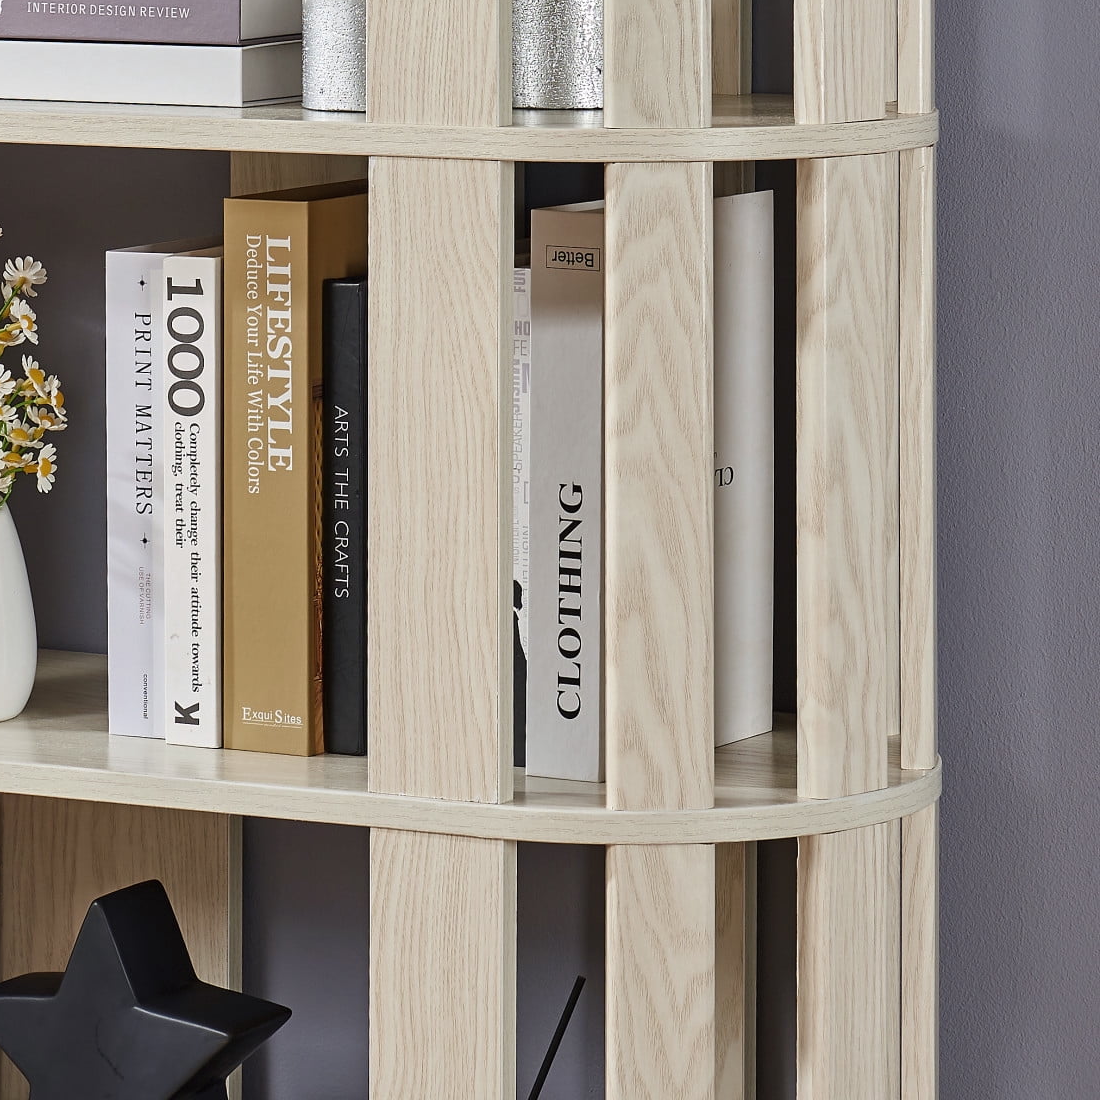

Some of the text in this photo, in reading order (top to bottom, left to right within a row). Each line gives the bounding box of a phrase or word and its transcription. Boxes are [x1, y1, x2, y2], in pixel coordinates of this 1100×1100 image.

[27, 2, 87, 15] INTERIOR
[89, 4, 136, 17] DESIGN
[140, 6, 190, 19] REVIEW
[166, 277, 205, 416] 1000
[266, 234, 292, 471] LIFESTYLE
[552, 250, 594, 268] Better
[134, 312, 153, 515] PRINT MATTERS
[246, 234, 265, 494] Deduce Your Life With Colors
[172, 422, 187, 548] clothing, treat their
[187, 423, 202, 692] Completely change their attitude towards
[334, 405, 350, 599] ARTS THE CRAFTS
[556, 480, 583, 720] CLOTHING
